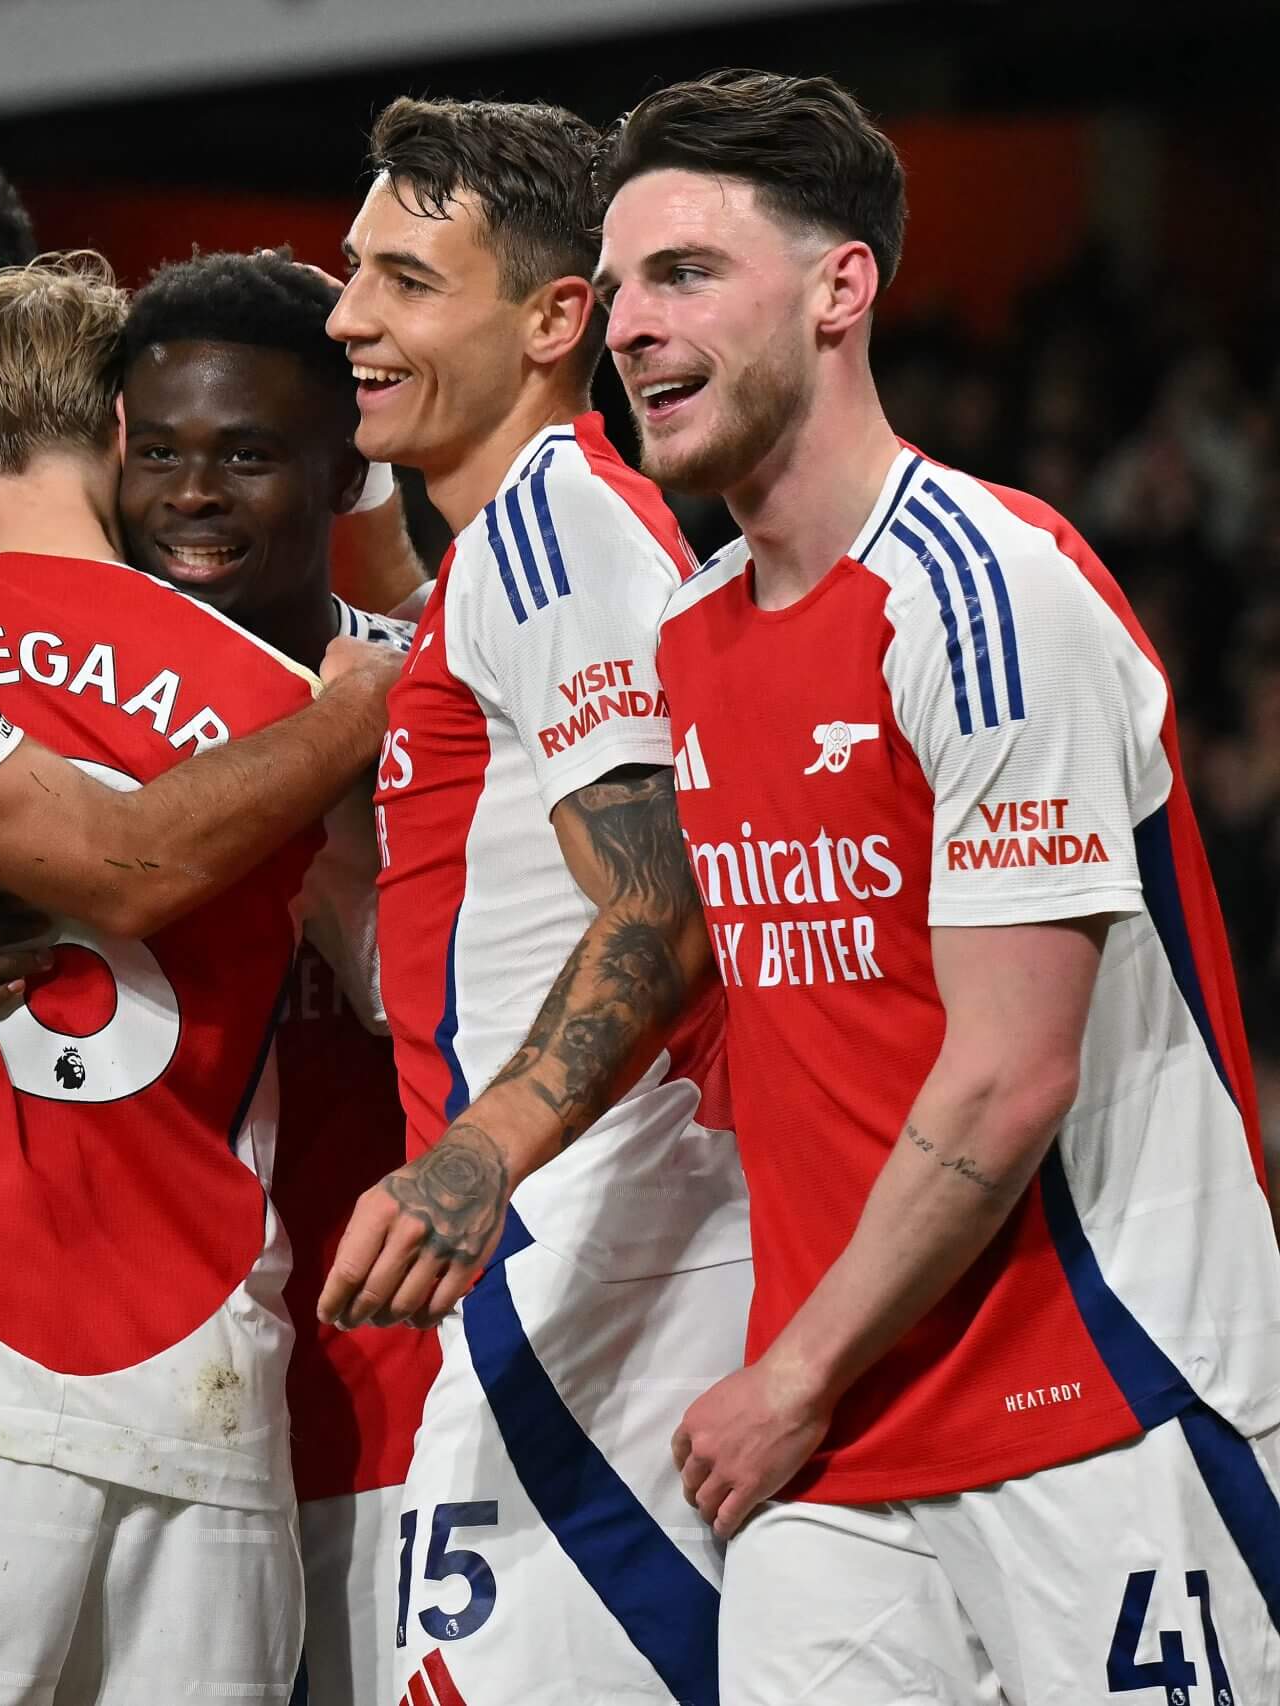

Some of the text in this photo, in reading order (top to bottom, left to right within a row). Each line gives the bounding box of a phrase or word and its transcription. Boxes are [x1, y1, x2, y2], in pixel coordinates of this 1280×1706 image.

[558, 659, 634, 706] VISIT
[538, 690, 672, 759] RWANDA
[977, 798, 1069, 833] VISIT
[682, 821, 903, 907] mirates
[947, 833, 1110, 871] RWANDA
[757, 915, 884, 987] BETTER
[1004, 1381, 1082, 1413] HEAT.RDY
[396, 1499, 499, 1649] 15
[1106, 1569, 1235, 1706] 41
